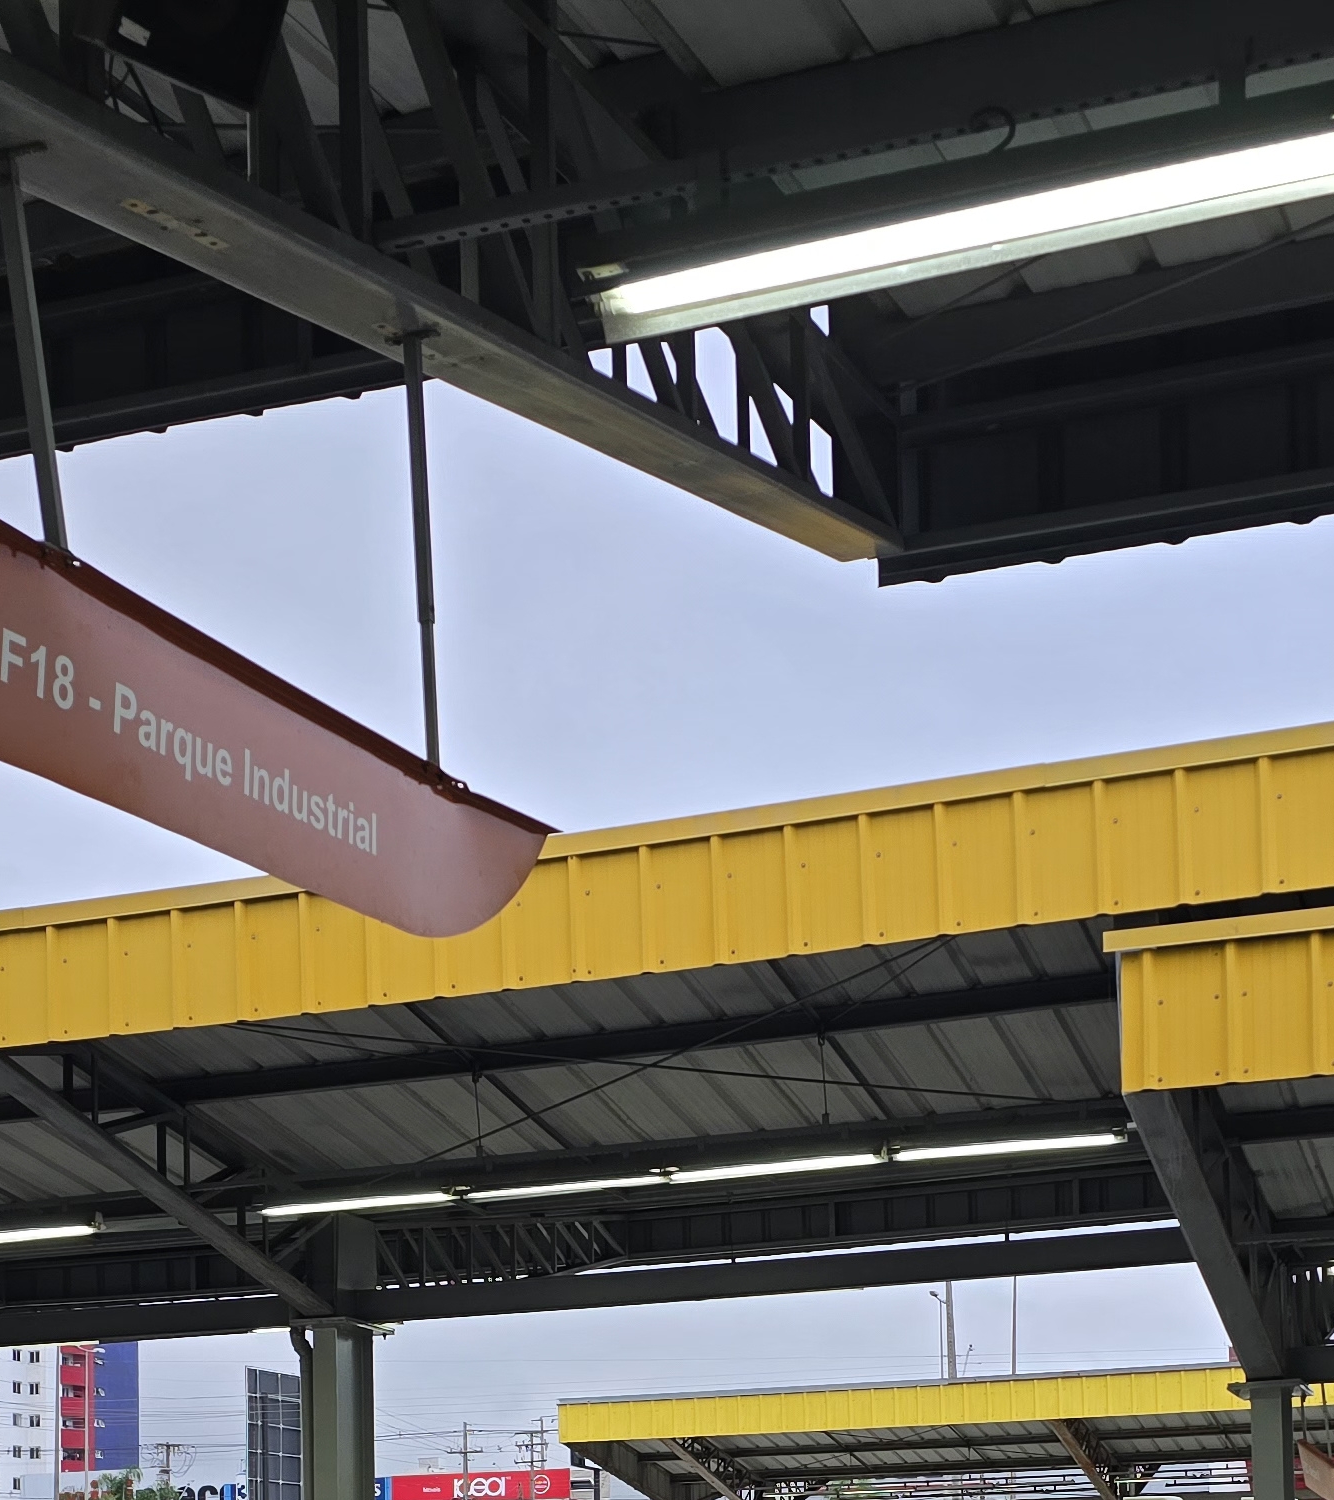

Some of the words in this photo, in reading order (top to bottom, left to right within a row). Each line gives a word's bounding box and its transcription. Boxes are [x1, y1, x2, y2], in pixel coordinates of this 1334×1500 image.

[0, 627, 76, 711] F18
[89, 696, 102, 711] -
[112, 681, 233, 787] Parque
[243, 747, 379, 857] Industrial
